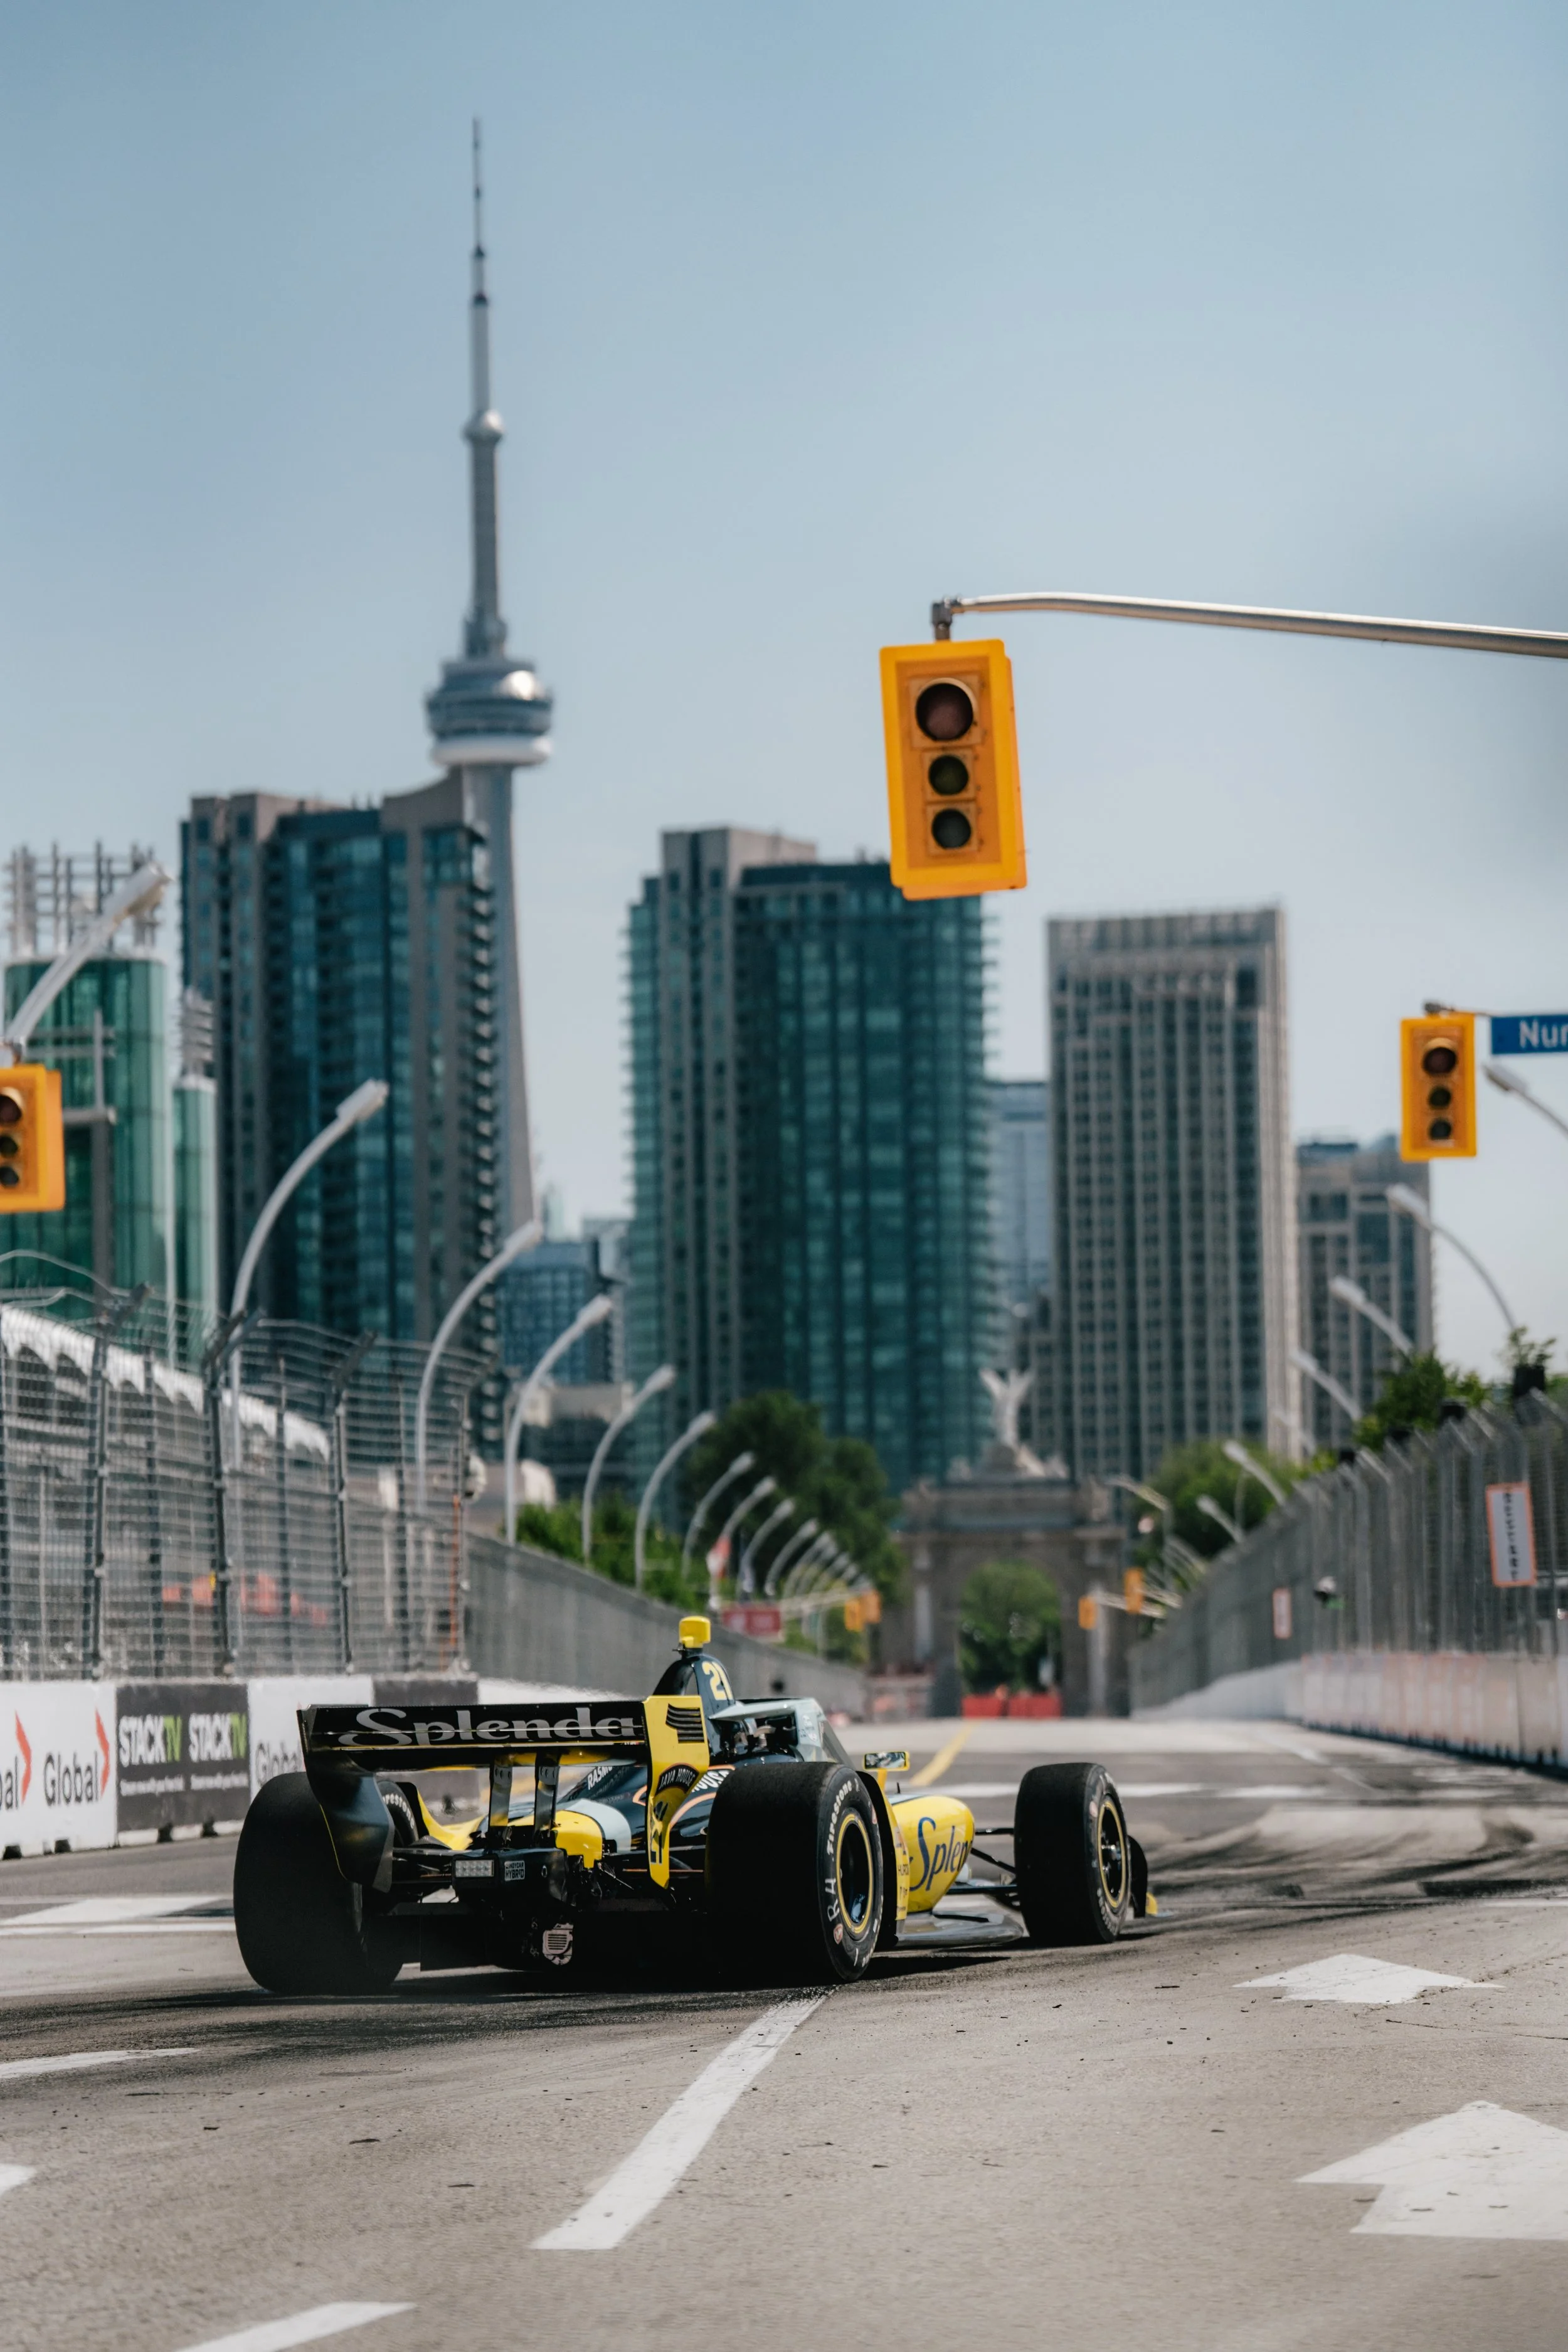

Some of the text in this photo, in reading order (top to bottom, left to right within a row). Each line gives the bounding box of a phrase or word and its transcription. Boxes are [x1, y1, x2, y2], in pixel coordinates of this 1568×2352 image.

[702, 1661, 734, 1704] 21
[338, 1707, 637, 1746] Splenda
[43, 1751, 98, 1807] Global
[659, 1768, 696, 1790] JAVA HOUSE
[826, 1780, 852, 1855] Firestone
[506, 1869, 524, 1879] HYBRID
